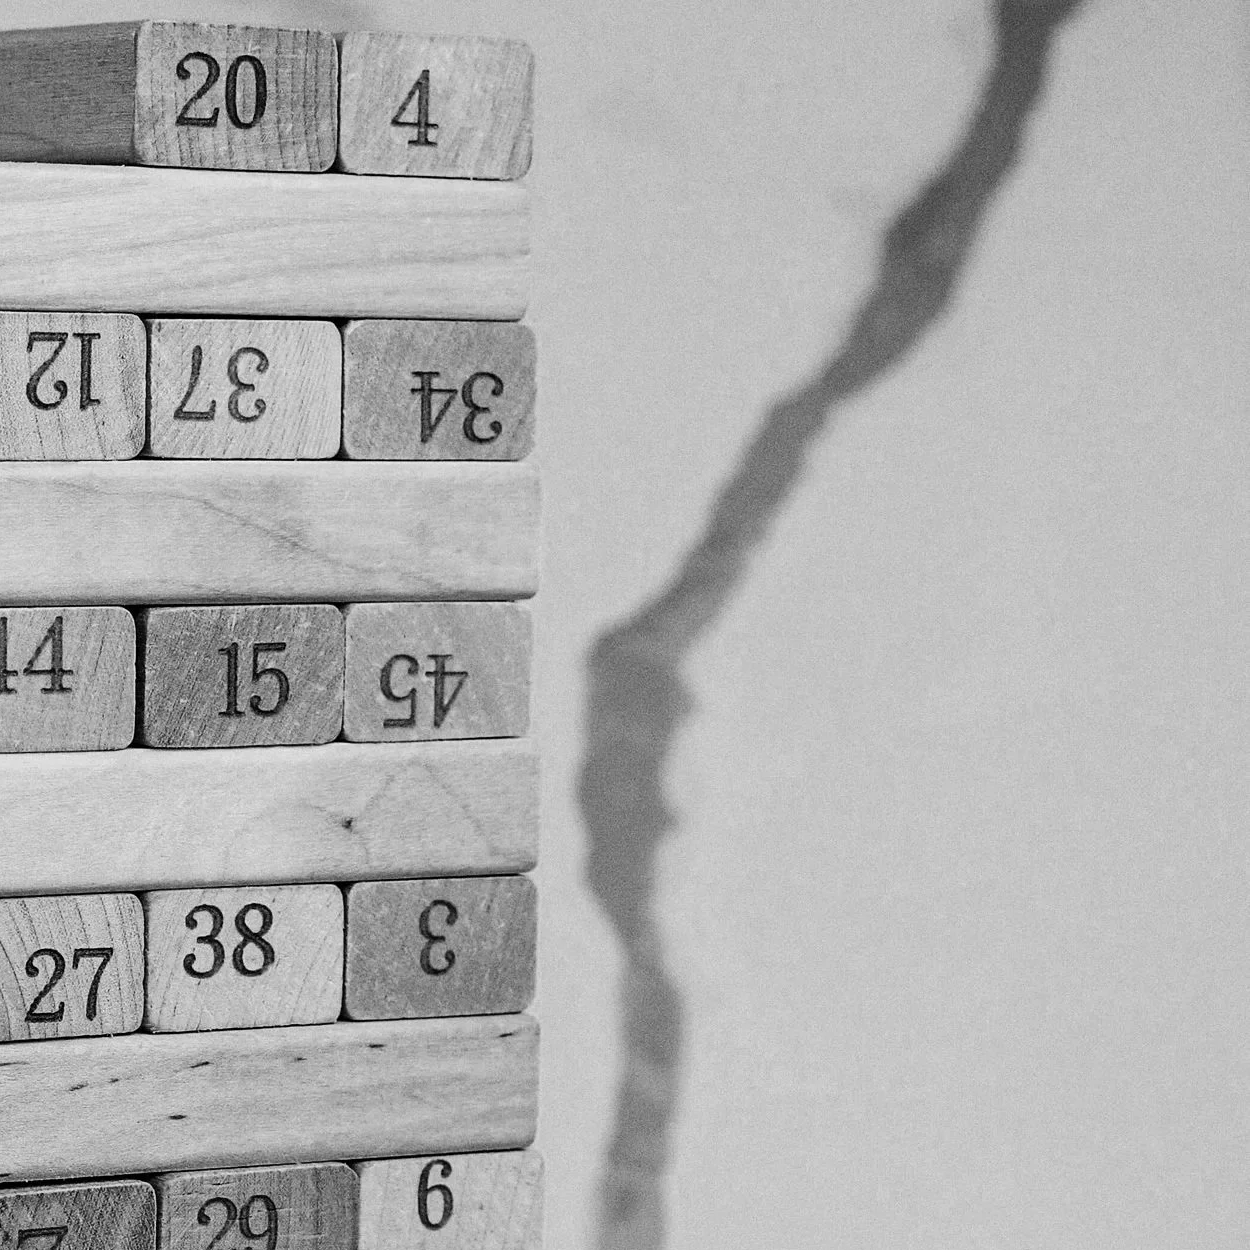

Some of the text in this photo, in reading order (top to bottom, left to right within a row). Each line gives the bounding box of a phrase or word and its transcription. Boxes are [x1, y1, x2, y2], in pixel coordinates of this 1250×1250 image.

[175, 51, 269, 131] 20
[389, 68, 441, 147] 4
[25, 330, 102, 412] 12
[174, 346, 271, 424] 37
[410, 370, 505, 445] 34
[218, 641, 291, 719] 15
[377, 652, 471, 730] 45
[183, 902, 275, 980] 38
[418, 899, 460, 975] 3
[24, 947, 114, 1025] 27
[416, 1158, 455, 1232] 6
